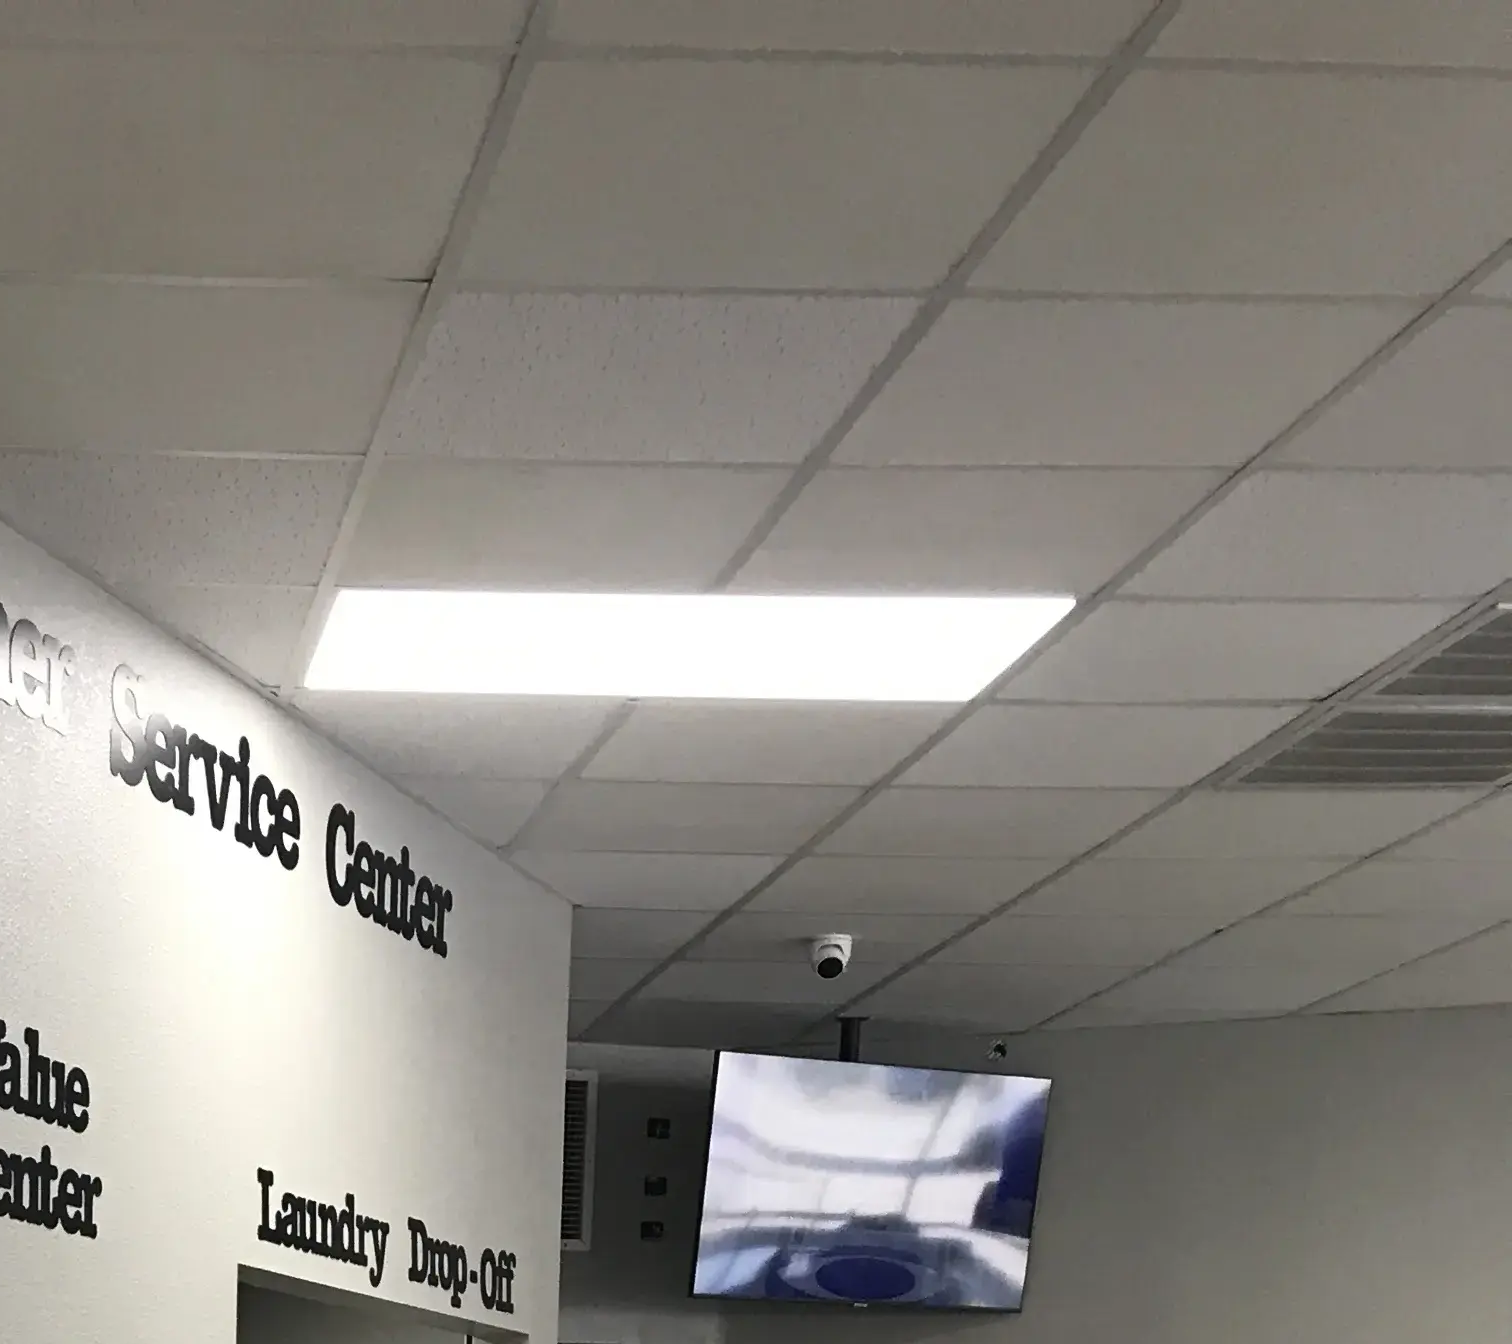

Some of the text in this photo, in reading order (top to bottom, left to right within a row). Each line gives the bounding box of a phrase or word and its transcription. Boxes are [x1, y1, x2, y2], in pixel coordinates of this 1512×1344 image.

[109, 663, 300, 870] Service
[326, 804, 452, 957] Center
[257, 1167, 516, 1314] Laundry Drop-Off
